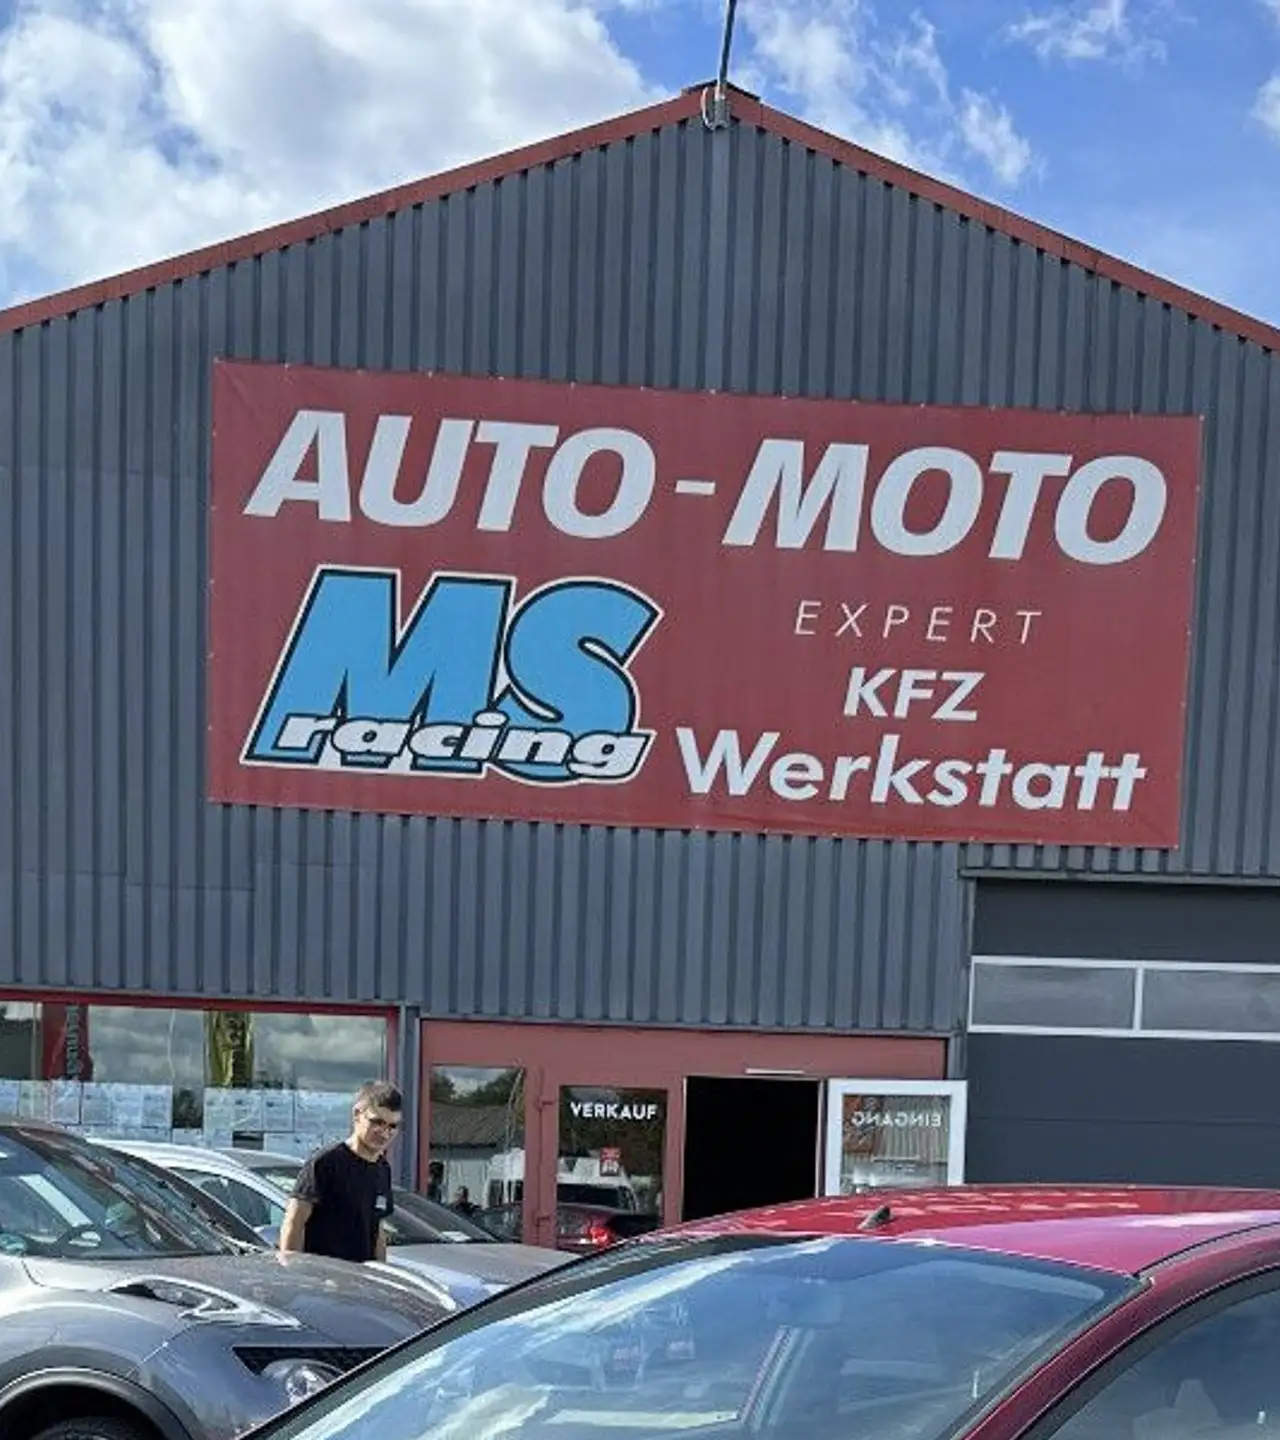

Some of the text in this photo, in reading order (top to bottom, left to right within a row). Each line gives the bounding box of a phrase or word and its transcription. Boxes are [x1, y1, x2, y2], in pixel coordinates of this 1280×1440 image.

[793, 600, 1042, 645] EXPERT
[843, 666, 987, 723] KFZ
[273, 710, 651, 778] racing
[675, 727, 1147, 812] Werkstatt
[570, 1101, 658, 1120] VERKAUF
